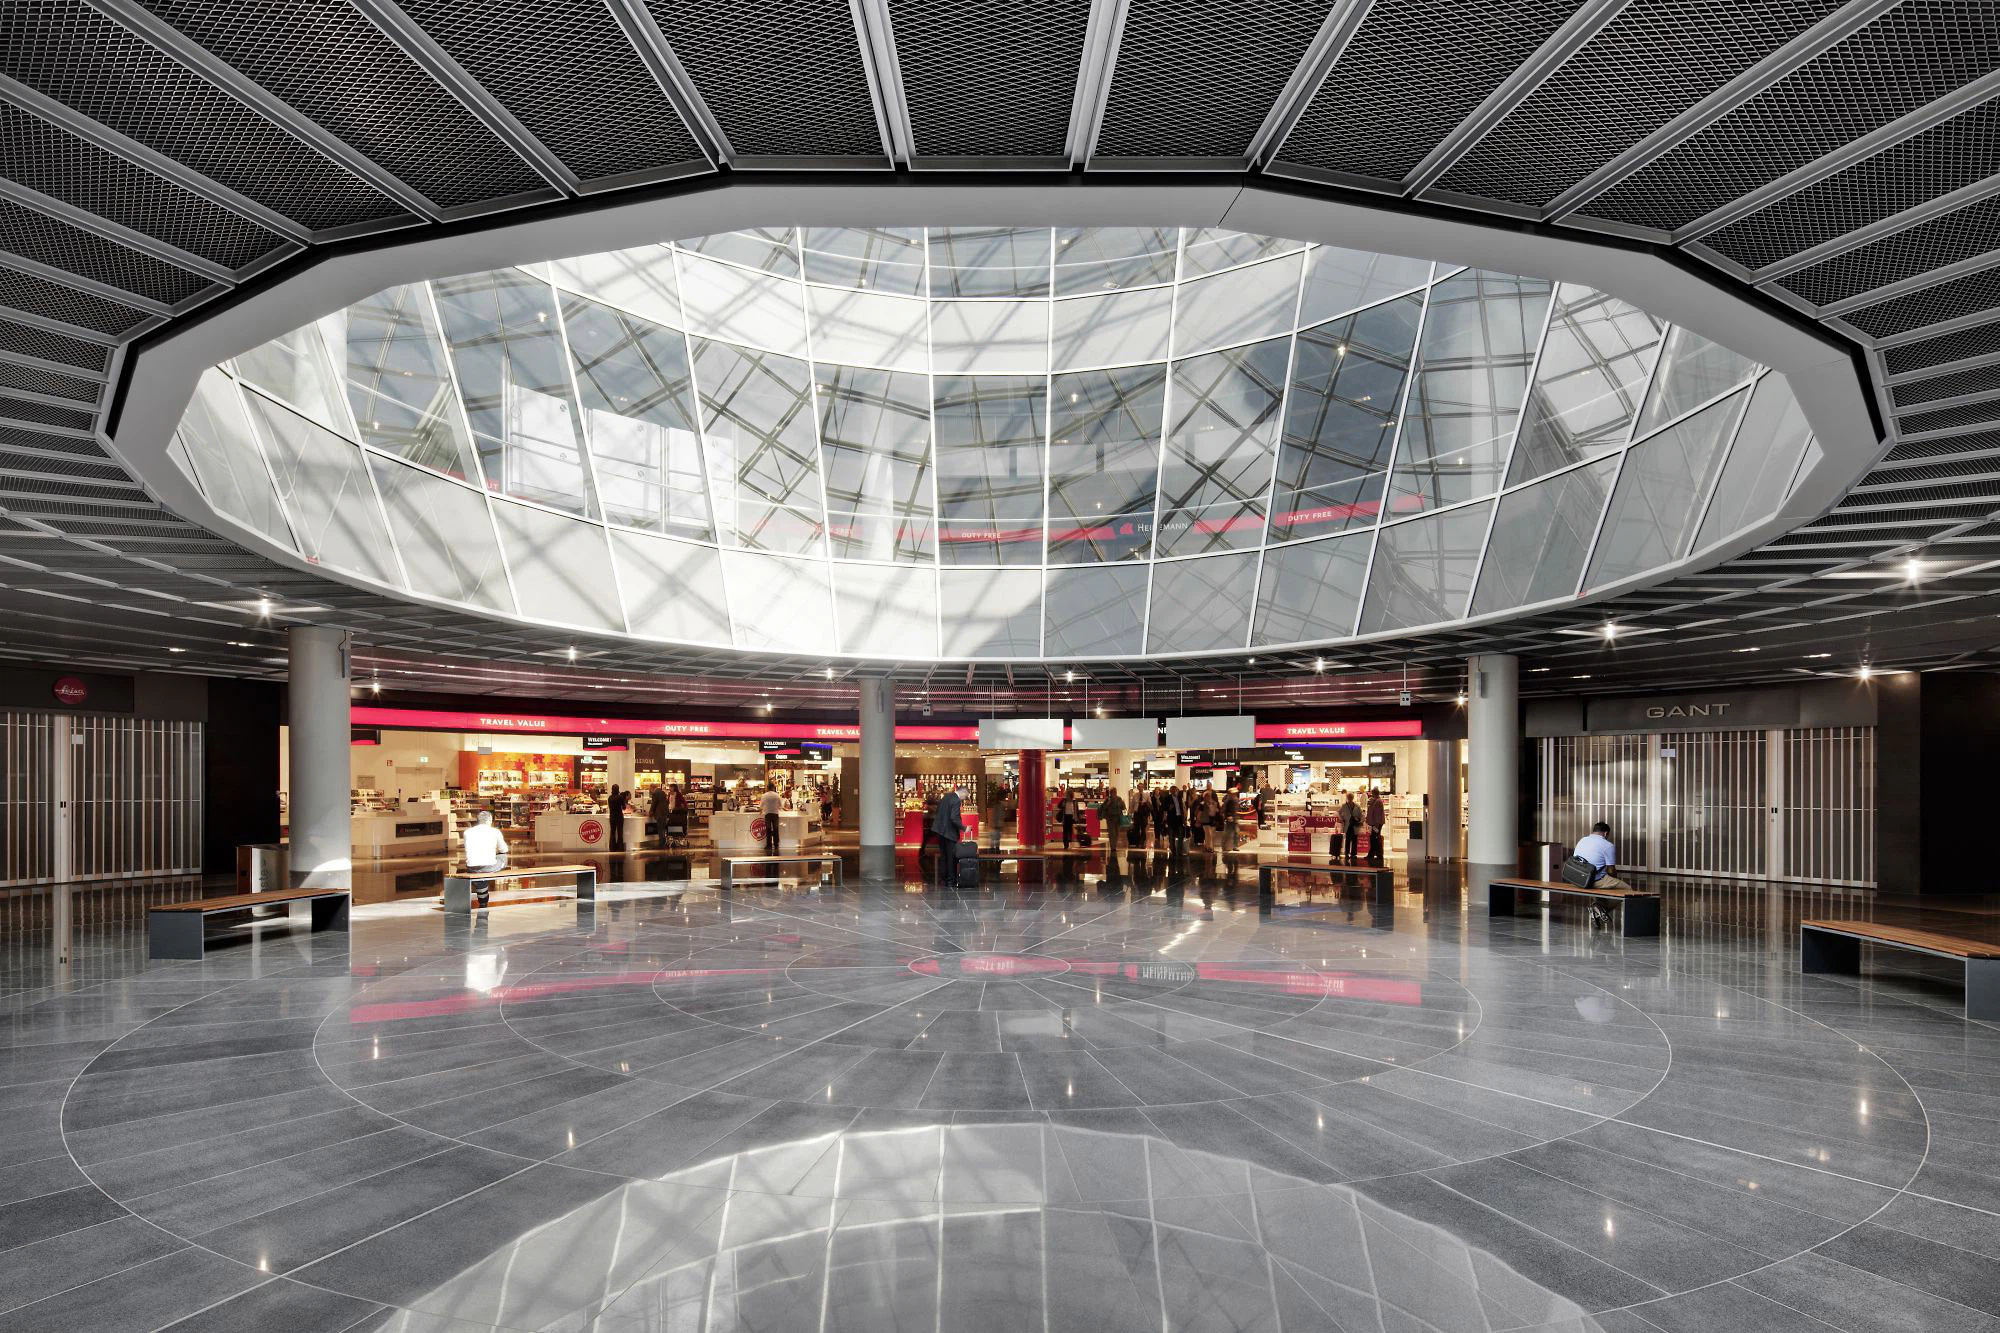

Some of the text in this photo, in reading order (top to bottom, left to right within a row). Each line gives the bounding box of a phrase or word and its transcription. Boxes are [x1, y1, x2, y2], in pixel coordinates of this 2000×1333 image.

[1288, 511, 1332, 522] DUTY FREE
[1137, 523, 1188, 532] HEIEMANN
[961, 531, 1001, 539] DUTY FREE
[1646, 703, 1731, 718] GANT
[480, 718, 514, 726] TRAVEL
[689, 725, 709, 733] FREE
[816, 728, 860, 737] TRAVEL VAL
[1287, 726, 1346, 735] TRAVEL VALUE
